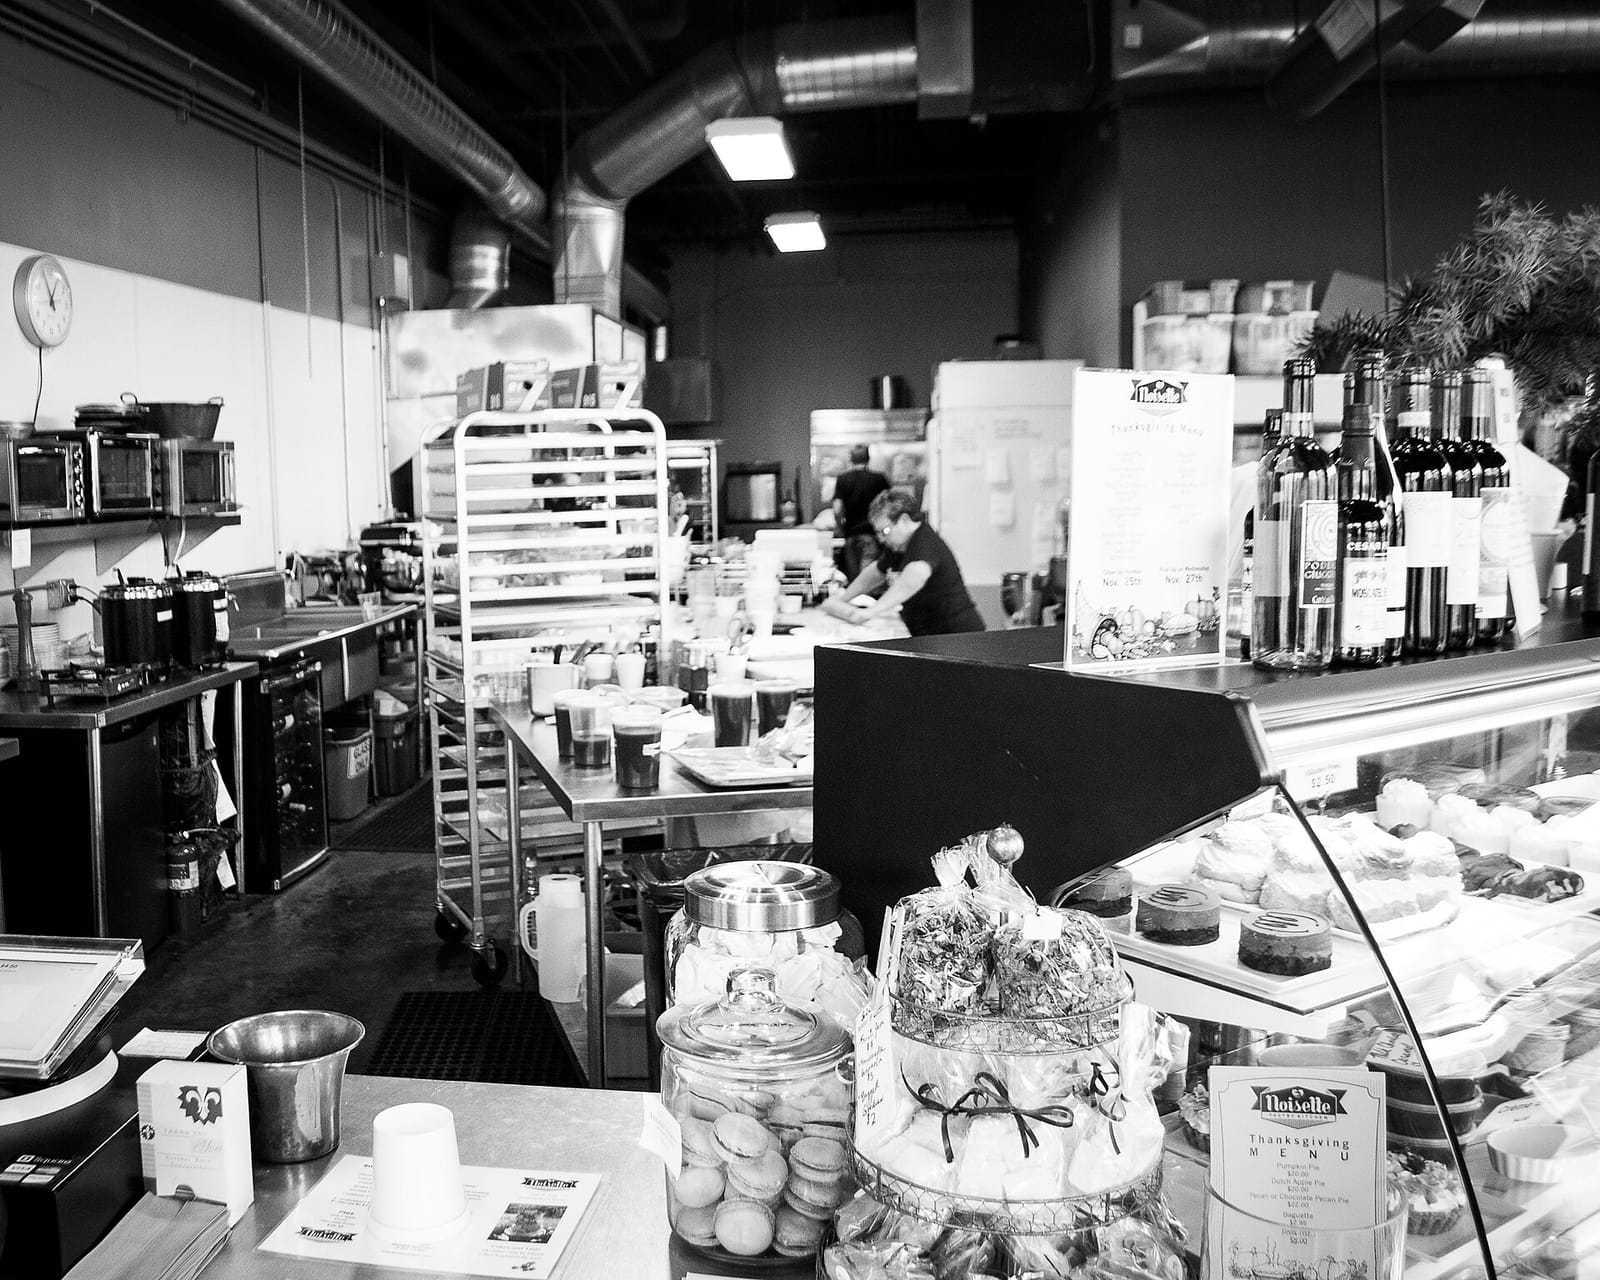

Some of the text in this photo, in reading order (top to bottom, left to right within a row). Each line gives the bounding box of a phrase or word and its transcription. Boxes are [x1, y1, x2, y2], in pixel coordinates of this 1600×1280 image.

[1139, 387, 1181, 403] Noisette
[1311, 773, 1336, 789] $2.50
[1265, 1094, 1331, 1114] Noisette
[1249, 1134, 1349, 1151] Thanksgiving
[1276, 1162, 1320, 1172] Pumpkin Pie
[1287, 1170, 1309, 1178] $20.00
[1271, 1178, 1325, 1187] Dutch Apple Pie
[1287, 1185, 1309, 1193] $20.00
[1249, 1192, 1269, 1200] Pecan
[1279, 1193, 1313, 1202] Chocolate
[1315, 1194, 1336, 1204] Pecan
[1337, 1196, 1349, 1204] Pie
[1282, 1211, 1313, 1220] Baguette
